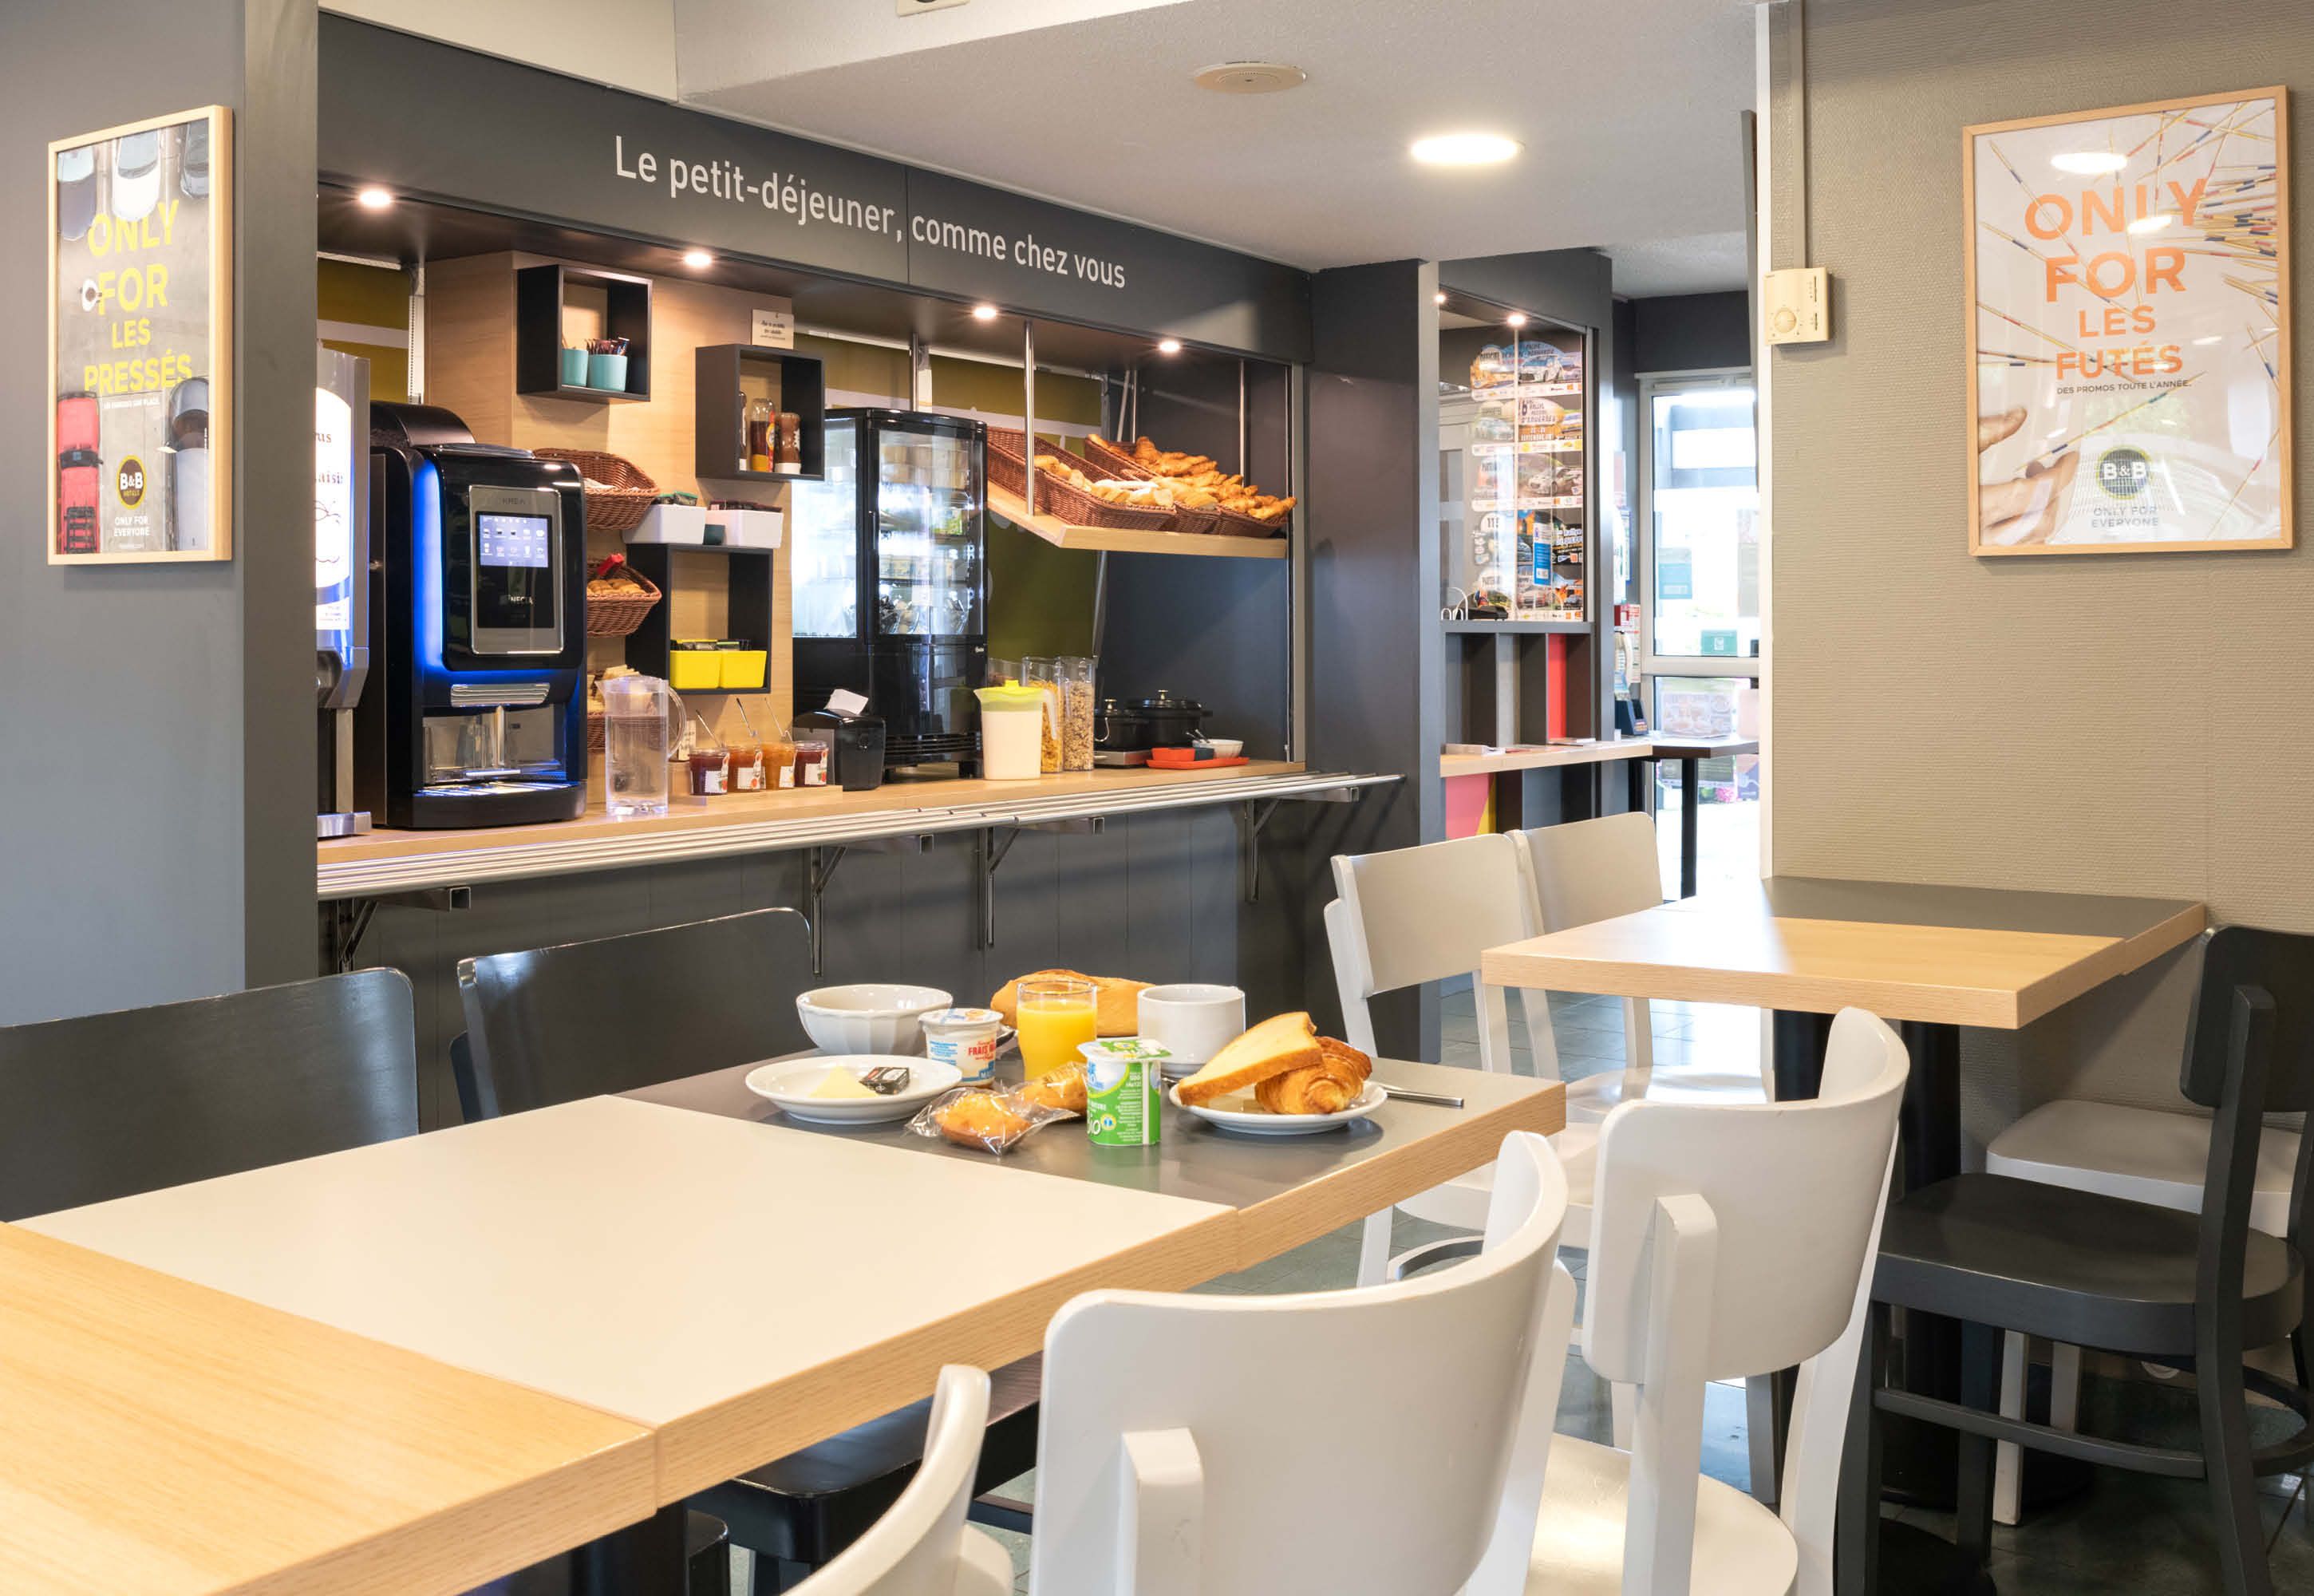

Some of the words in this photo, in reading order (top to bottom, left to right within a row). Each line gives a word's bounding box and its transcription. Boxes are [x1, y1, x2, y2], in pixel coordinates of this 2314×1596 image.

[616, 136, 657, 183] Le
[669, 158, 902, 243] petit-déjeuner,
[911, 215, 1006, 260] comme
[1014, 234, 1068, 275] chez
[1074, 254, 1126, 288] vous
[87, 200, 180, 257] ONLY
[2045, 247, 2187, 302] FOR
[97, 263, 169, 316] FOR
[112, 317, 152, 349] LES
[2079, 305, 2156, 338] LES
[84, 348, 193, 396] PRESSÉS
[2056, 339, 2184, 381] FUTÉS
[2057, 386, 2075, 395] DES
[2076, 384, 2115, 393] PROMOS
[2117, 381, 2146, 391] TOUTE
[120, 472, 144, 490] B&B
[2103, 460, 2146, 480] B&B
[114, 516, 132, 526] ONLY
[134, 516, 148, 525] FOR
[2091, 517, 2159, 528] EVERYONE
[2093, 507, 2126, 517] ONLY
[2131, 506, 2158, 516] FOR
[113, 526, 151, 537] EVERYONE
[967, 1045, 989, 1056] FRAIS
